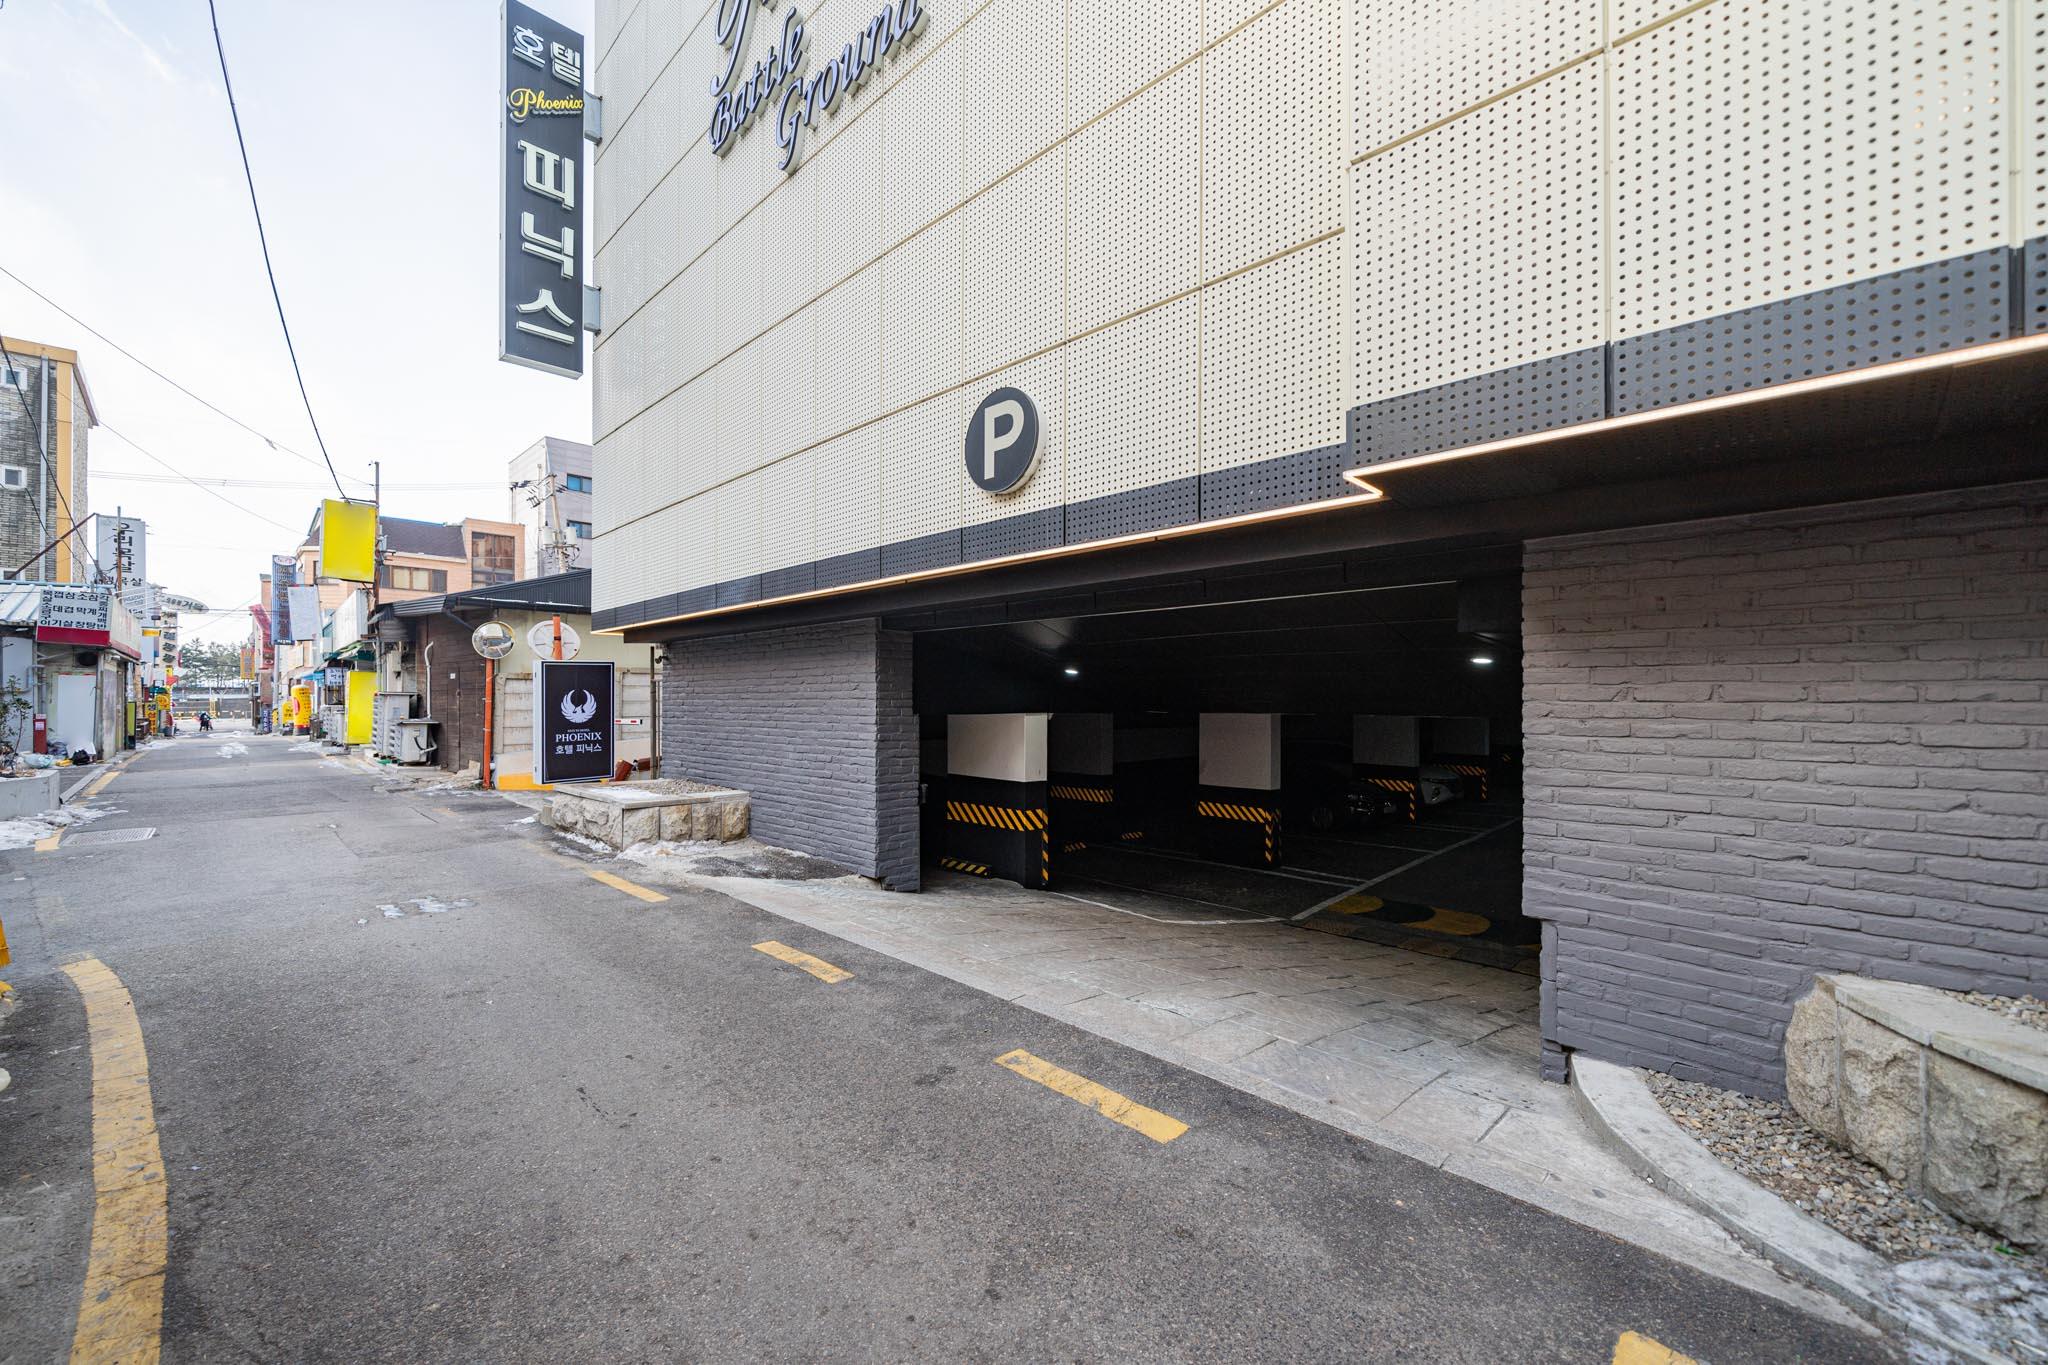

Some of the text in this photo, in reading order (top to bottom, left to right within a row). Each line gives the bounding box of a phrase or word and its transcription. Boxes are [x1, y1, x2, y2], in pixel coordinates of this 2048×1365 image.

[513, 25, 581, 87] 호텔
[709, 6, 806, 155] Battle
[508, 88, 584, 121] Phoenix
[516, 140, 575, 345] 피닉스
[984, 400, 1024, 480] P
[555, 732, 602, 743] PHOENIX
[555, 743, 602, 755] 호텔 피닉스
